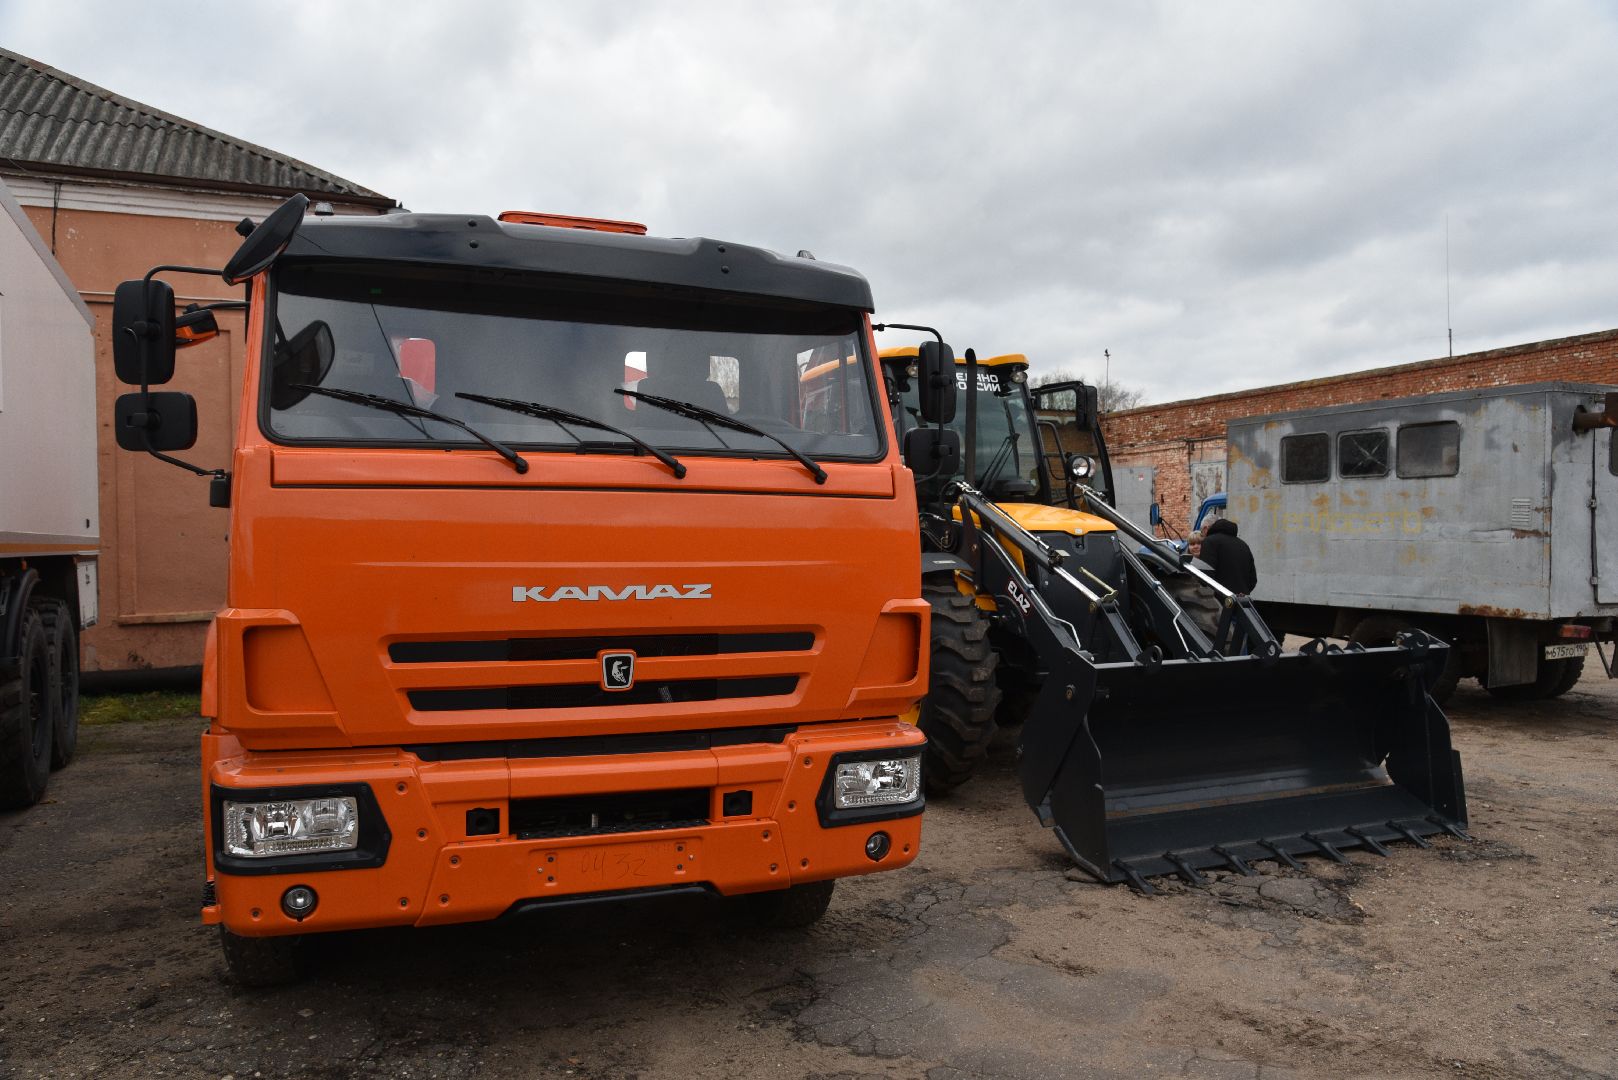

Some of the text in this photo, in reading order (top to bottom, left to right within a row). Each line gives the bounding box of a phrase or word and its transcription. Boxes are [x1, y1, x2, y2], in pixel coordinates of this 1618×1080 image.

[955, 381, 1001, 392] ОСИИ
[512, 583, 712, 602] KAMAZ
[1008, 580, 1031, 613] ELAZ
